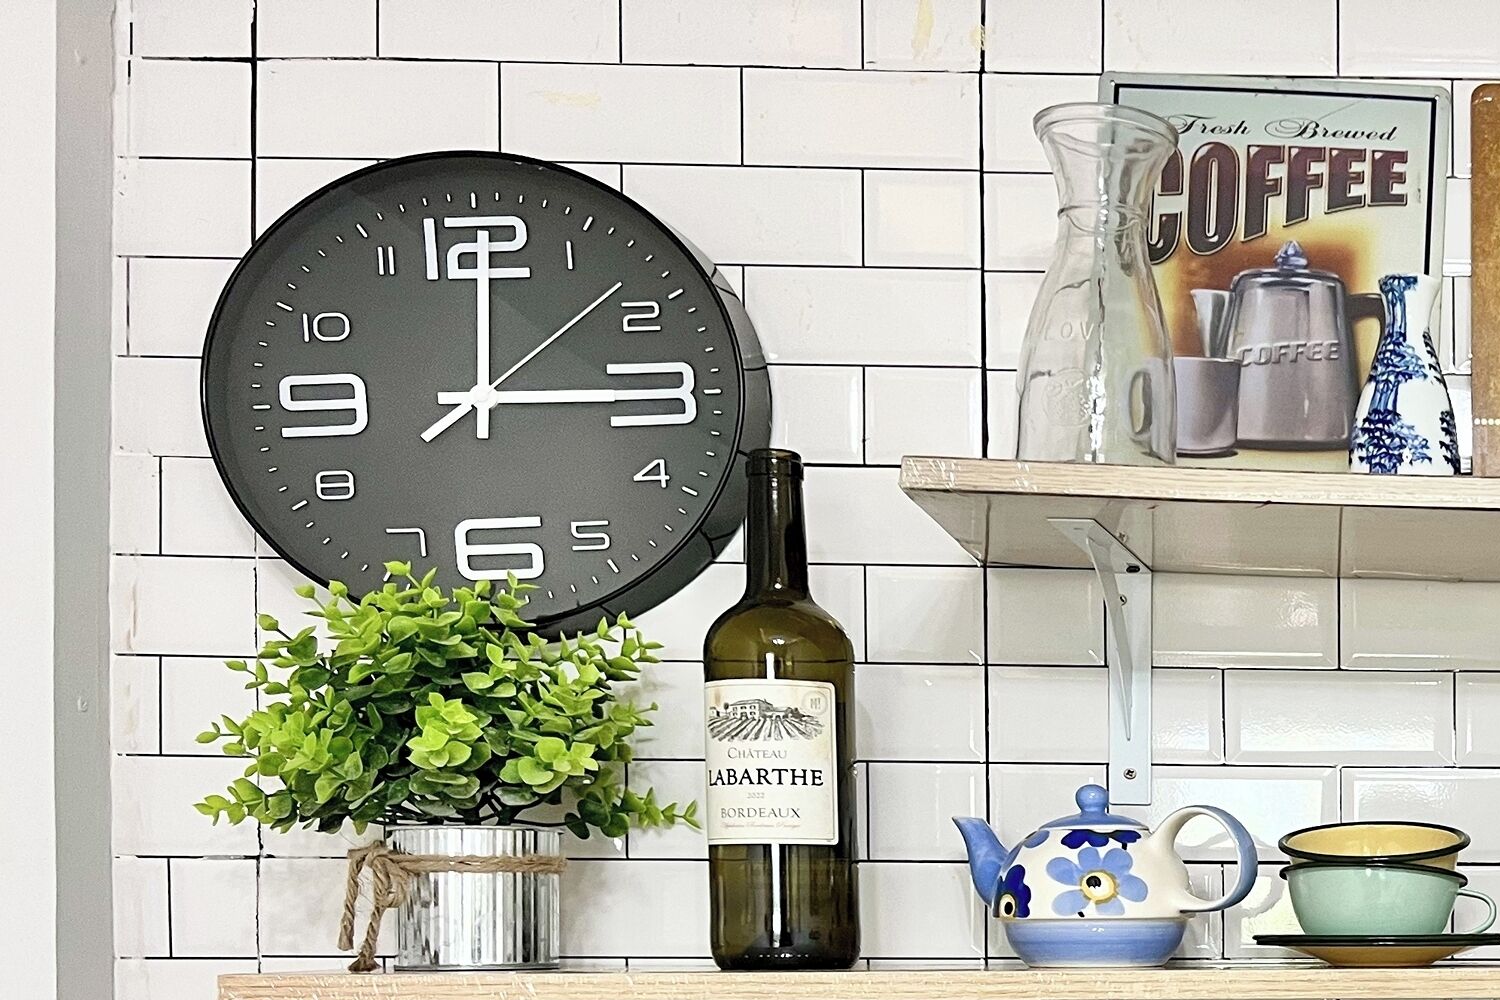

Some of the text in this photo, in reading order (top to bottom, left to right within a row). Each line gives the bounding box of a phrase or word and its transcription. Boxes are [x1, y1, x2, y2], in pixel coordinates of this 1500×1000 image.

[1165, 114, 1398, 142] Fresh Brewed
[1146, 143, 1409, 264] COFFEE
[423, 215, 531, 280] 12
[302, 312, 350, 342] 10
[621, 300, 661, 331] 2
[1236, 341, 1339, 367] COFFEE
[278, 373, 368, 438] 9
[606, 361, 697, 426] 3
[315, 470, 354, 500] 8
[633, 459, 670, 489] 4
[386, 527, 428, 556] 7
[454, 516, 544, 581] 6
[571, 520, 610, 550] 5
[708, 767, 824, 787] LABARTHE
[720, 807, 801, 819] BORDEAUX
